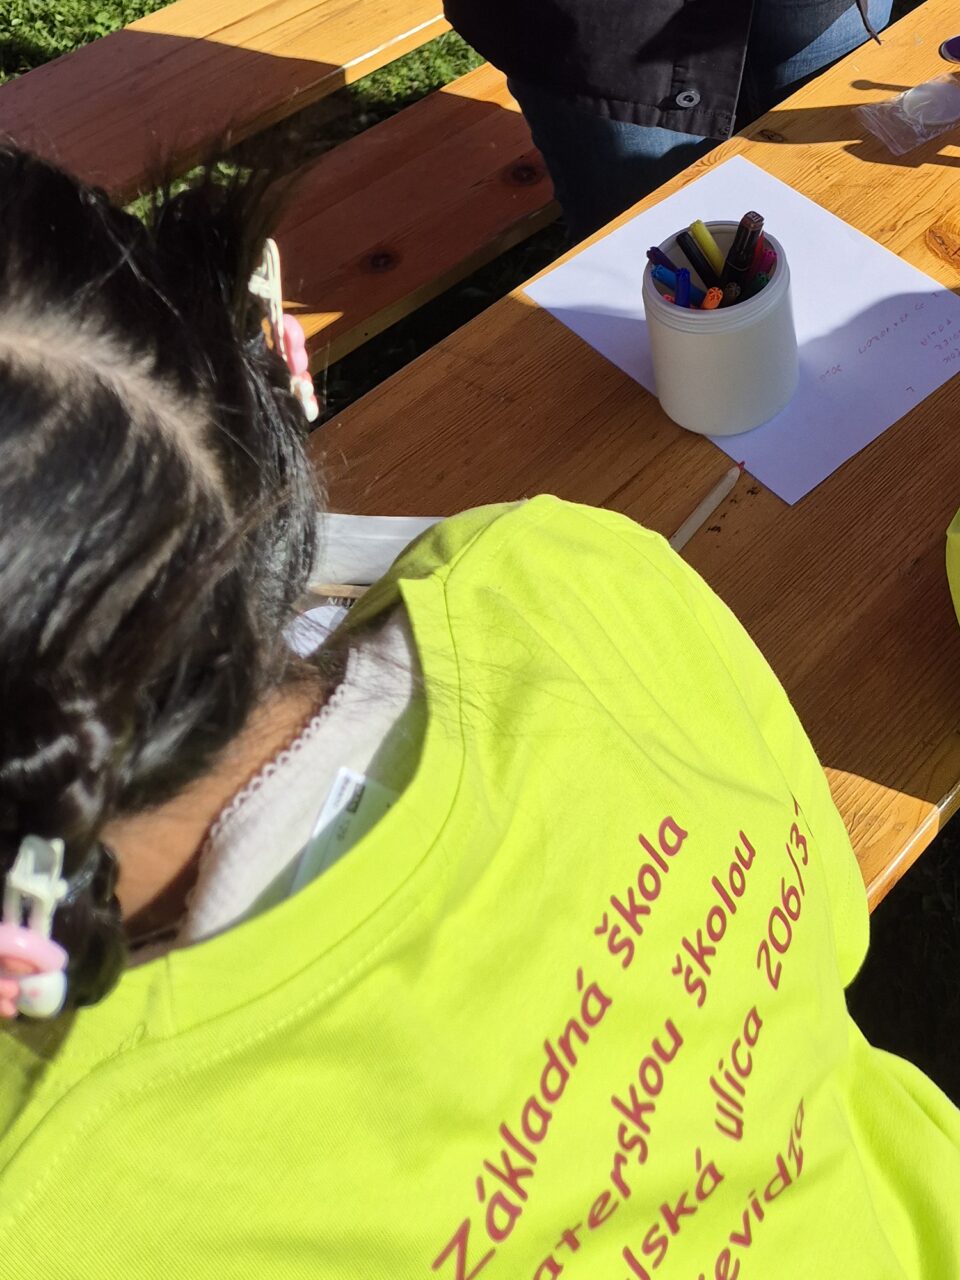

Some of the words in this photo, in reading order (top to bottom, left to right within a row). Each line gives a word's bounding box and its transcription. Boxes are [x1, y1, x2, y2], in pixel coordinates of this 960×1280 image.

[431, 966, 613, 1280] Základná
[594, 815, 689, 969] škola
[532, 1017, 684, 1280] aterskou
[671, 830, 757, 1008] školou
[709, 1005, 764, 1142] ulica
